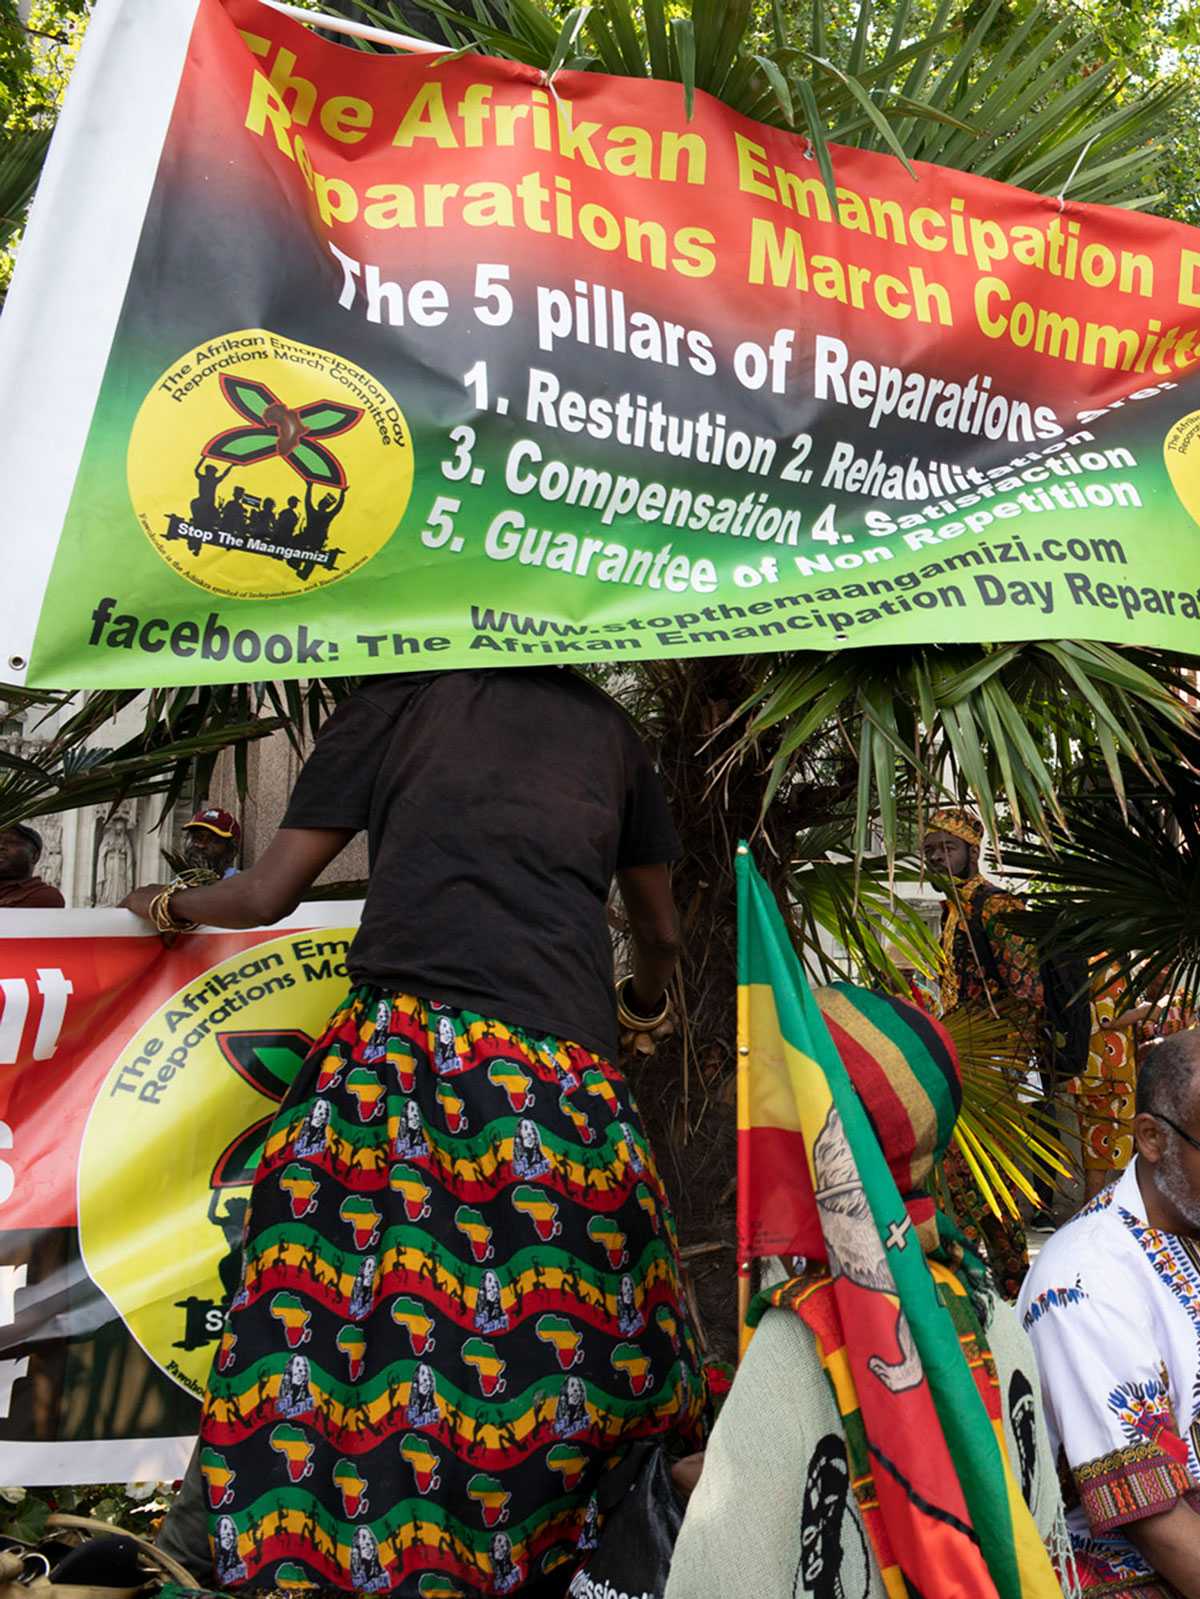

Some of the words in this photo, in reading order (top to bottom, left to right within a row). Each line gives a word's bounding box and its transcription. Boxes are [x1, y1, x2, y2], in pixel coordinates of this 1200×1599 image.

[239, 29, 375, 144] The
[391, 81, 707, 186] Afrikan
[734, 131, 1155, 299] Emancipation
[748, 217, 953, 328] March
[159, 362, 192, 394] The
[195, 335, 266, 366] Afrikan
[269, 336, 388, 405] Emancipation
[386, 406, 406, 449] Day
[171, 349, 270, 403] Reparations
[273, 349, 325, 372] March
[328, 367, 392, 447] Committee
[328, 240, 451, 328] The
[473, 263, 514, 327] 5
[536, 279, 717, 377] pillars
[733, 328, 796, 394] of
[814, 334, 1065, 443] Reparations
[441, 425, 487, 485] 3.
[505, 438, 802, 547] Compensation
[811, 503, 855, 546] 4.
[864, 446, 1139, 537] Satisfaction
[463, 361, 509, 415] 1.
[526, 368, 777, 477] Restitution
[780, 433, 814, 485] 2.
[821, 430, 1096, 501] Rehabilitation
[177, 522, 214, 542] Stop
[218, 531, 244, 547] The
[246, 538, 330, 564] Maangamizi
[420, 496, 465, 553] 5.
[484, 510, 719, 594] Guarantee
[732, 556, 780, 588] of
[794, 545, 895, 577] Non
[902, 478, 1144, 552] Repetition
[88, 596, 341, 665] facebook:
[357, 633, 452, 658] The
[470, 631, 642, 654] Afrikan
[658, 579, 967, 648] Emancipation
[974, 572, 1054, 614] Day
[110, 1036, 165, 1098] The
[164, 951, 285, 1035] Afrikan
[138, 972, 297, 1105] Reparations
